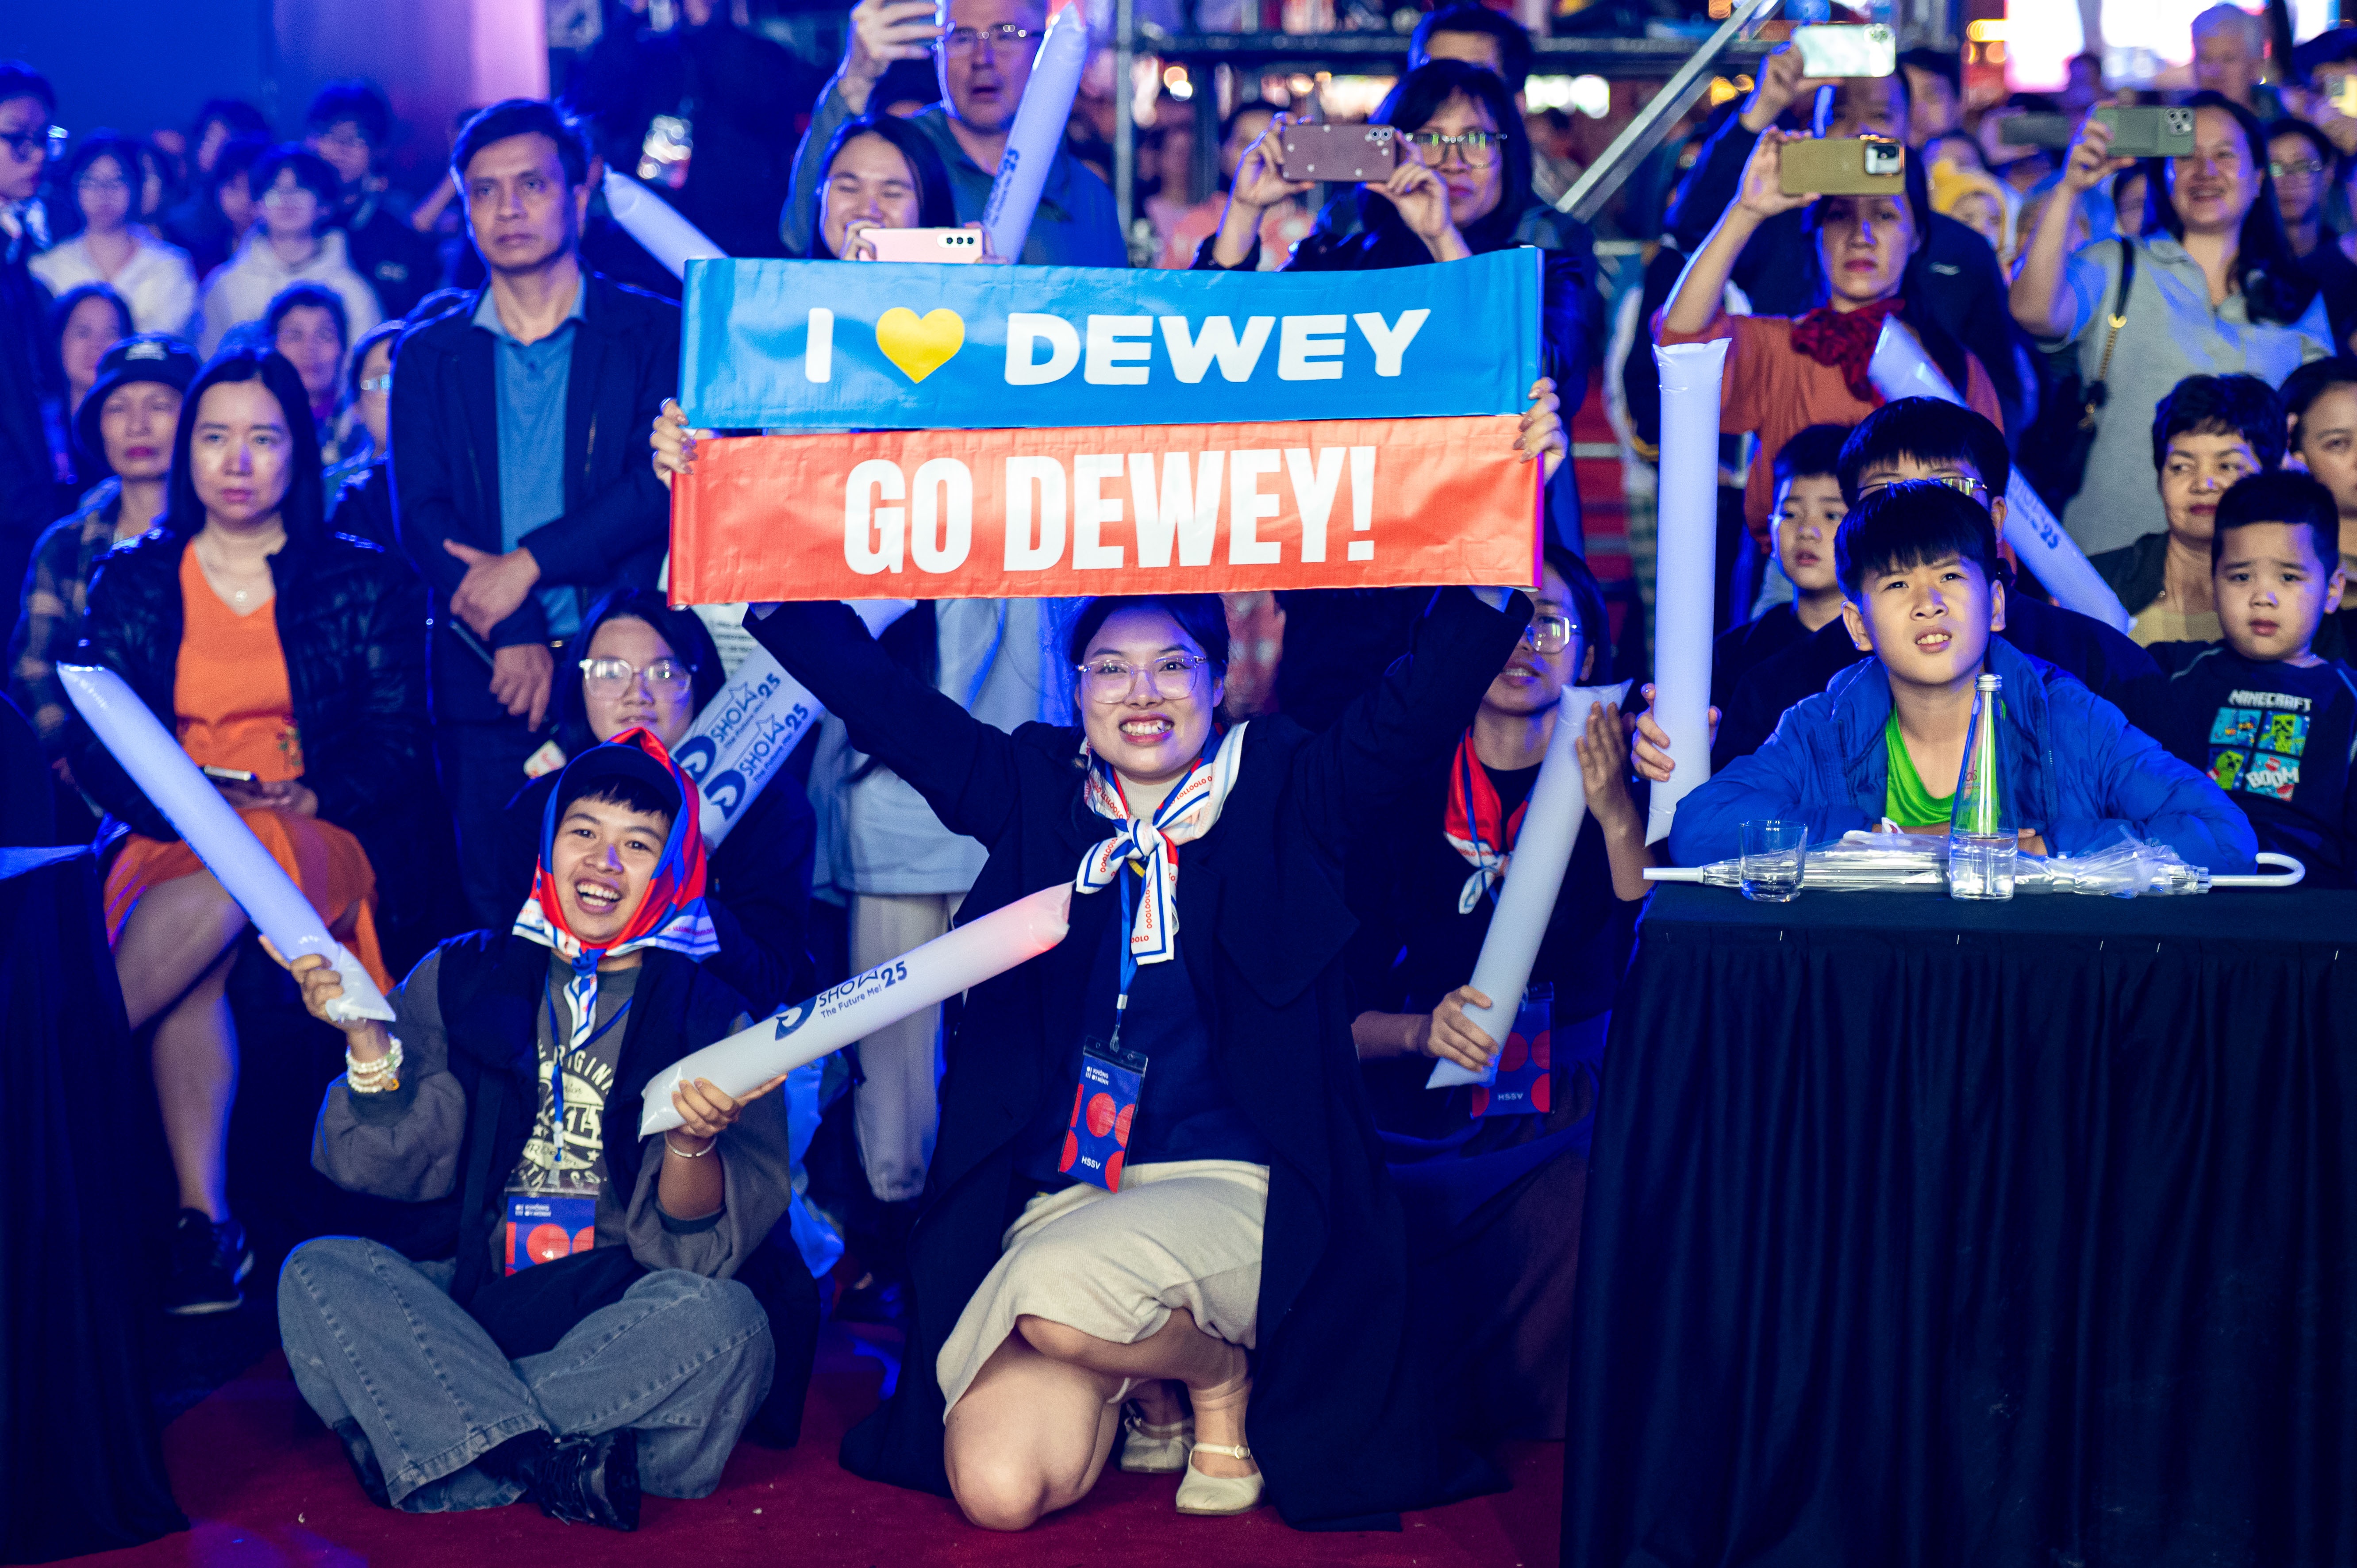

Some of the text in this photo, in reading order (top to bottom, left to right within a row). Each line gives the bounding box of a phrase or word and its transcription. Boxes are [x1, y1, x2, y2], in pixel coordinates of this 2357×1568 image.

[805, 307, 1430, 385] I DEWEY
[843, 445, 1377, 575] GO DEWEY!
[757, 673, 781, 699] 25
[2227, 689, 2312, 712] MINECRAFT
[785, 703, 809, 731] 25
[2245, 766, 2299, 788] BOOM
[881, 961, 907, 989] 25
[821, 984, 882, 1019] The Future Me!
[1497, 1092, 1523, 1101] HSSV
[1081, 1156, 1101, 1170] HSSV
